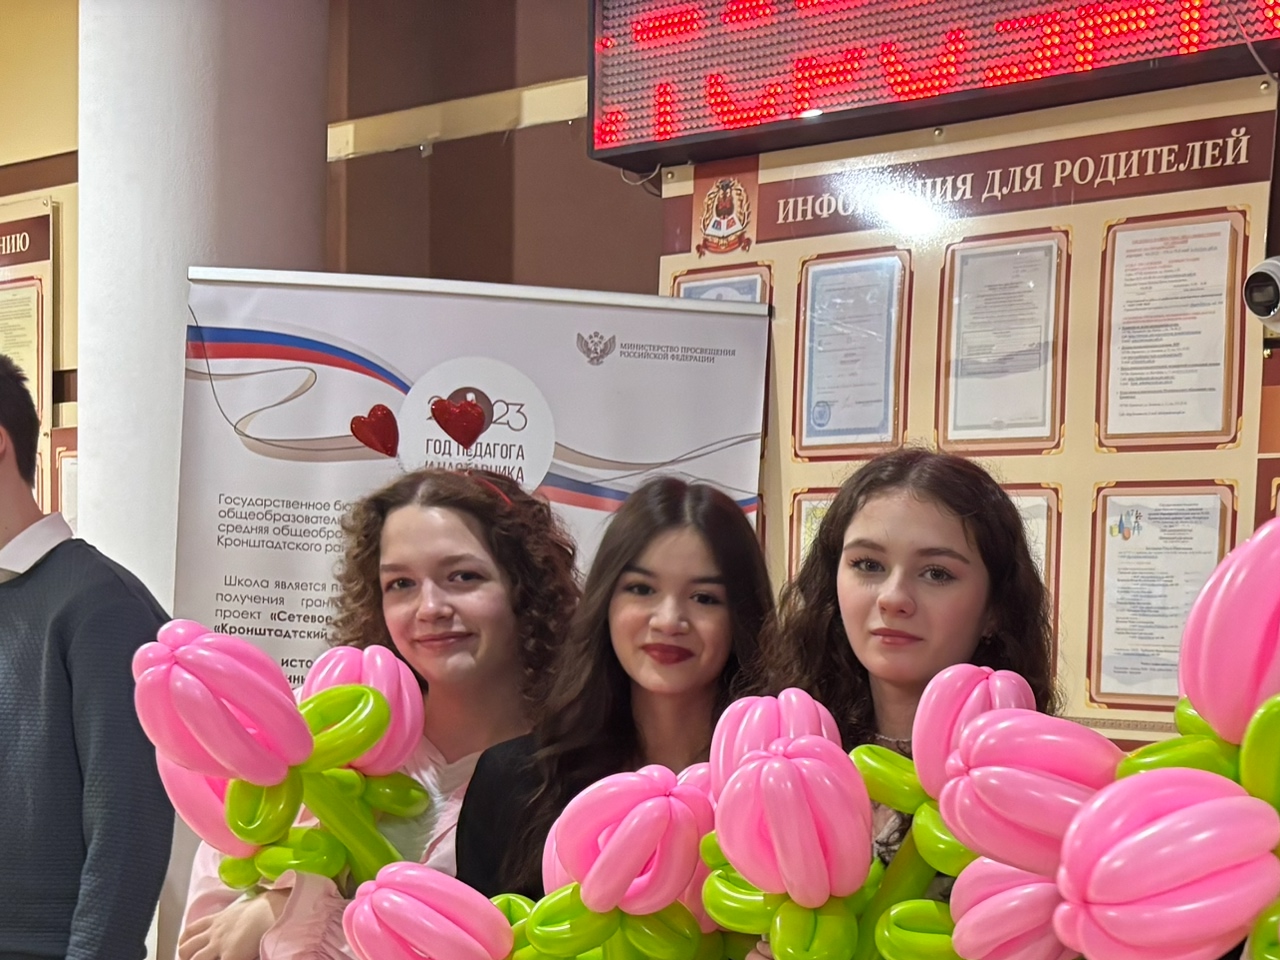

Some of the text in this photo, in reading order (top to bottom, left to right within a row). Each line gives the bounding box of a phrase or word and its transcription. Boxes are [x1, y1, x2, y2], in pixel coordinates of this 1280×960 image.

[776, 127, 1251, 225] ИНФОЦИЯ ДЛЯ РОДИТЕЛЕЙ
[620, 342, 680, 354] МИНИСТЕРСТВО
[619, 350, 716, 364] РОССИЙСКОЙ ФЕДЕРАЦИИ
[425, 438, 452, 458] ГОД
[218, 493, 331, 511] Государственное
[218, 508, 341, 525] общеобразовател
[217, 523, 270, 535] средняя
[216, 535, 322, 552] Кронштадтского
[223, 575, 270, 589] Школа
[274, 580, 327, 592] является
[215, 592, 285, 606] получения
[214, 608, 333, 624] проект «Сетевое
[213, 623, 328, 640] «Кронштадтский
